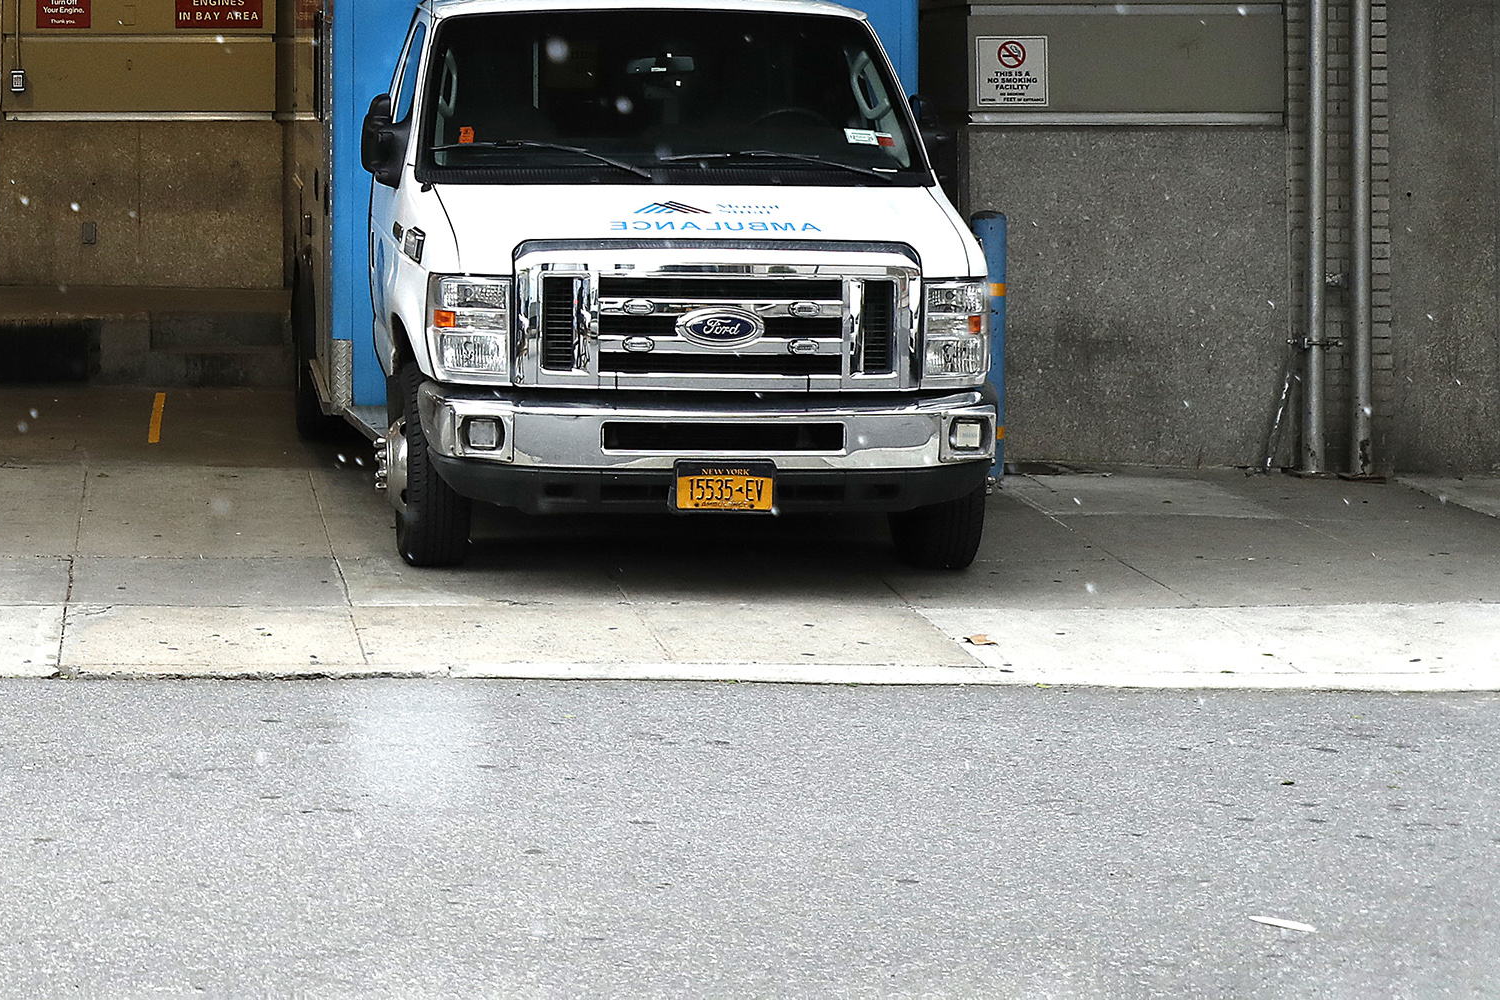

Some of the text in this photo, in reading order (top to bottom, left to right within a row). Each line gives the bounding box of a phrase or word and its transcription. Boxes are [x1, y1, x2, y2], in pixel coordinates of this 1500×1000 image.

[42, 6, 85, 15] Your Engine.
[179, 11, 259, 21] IN BAY AREA
[702, 318, 741, 336] Ford
[701, 468, 750, 476] NEW YORK
